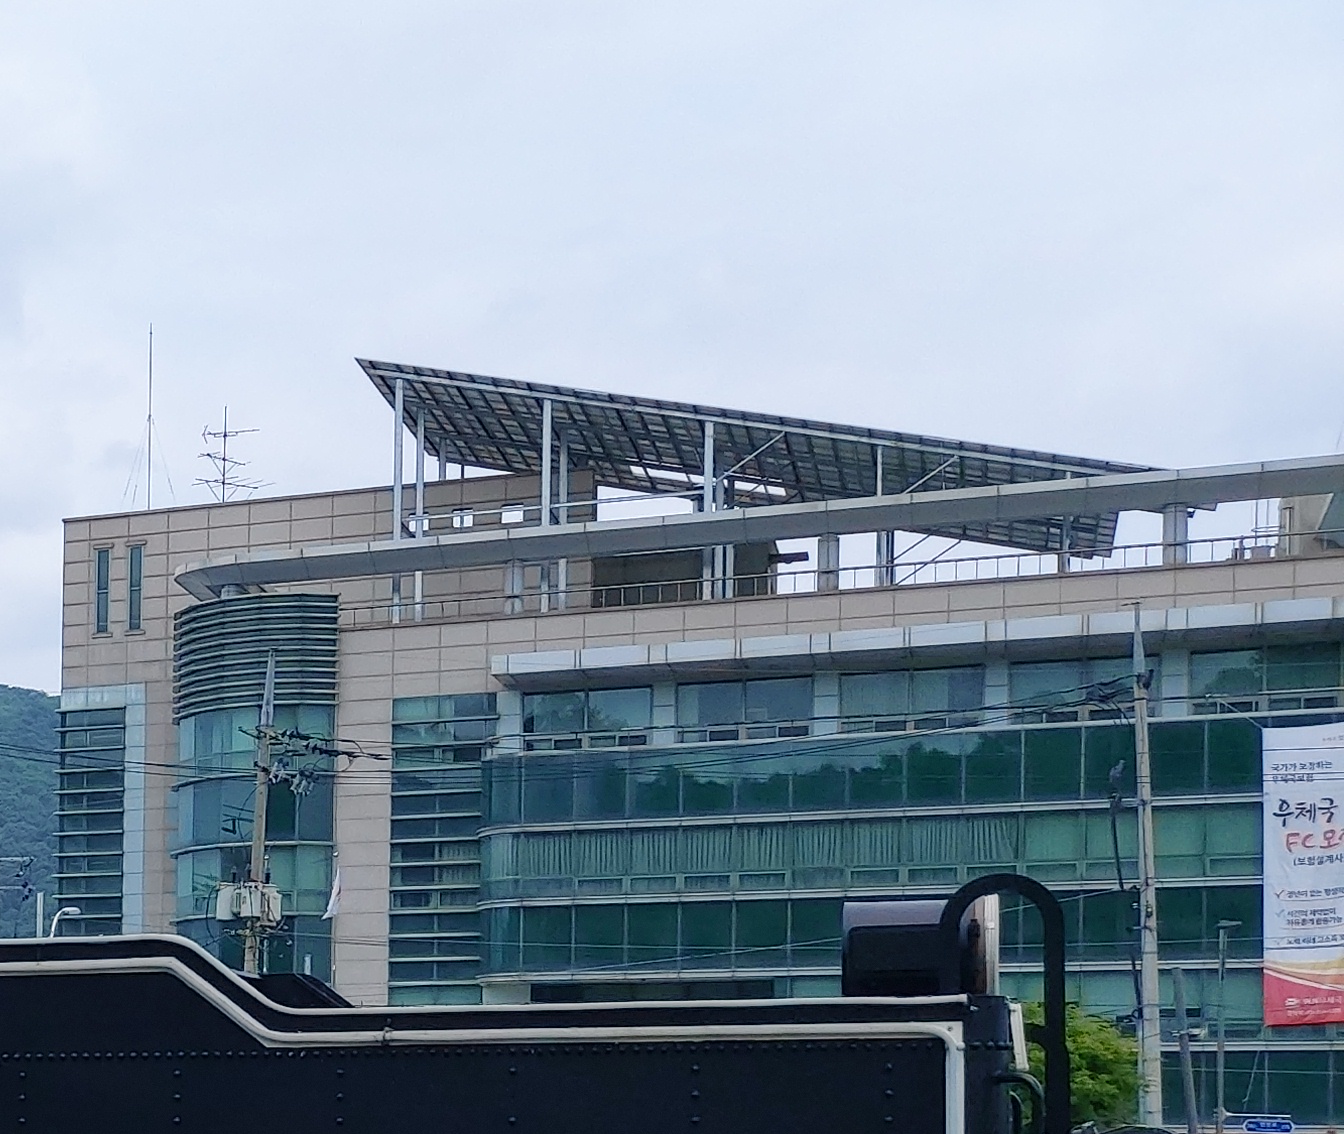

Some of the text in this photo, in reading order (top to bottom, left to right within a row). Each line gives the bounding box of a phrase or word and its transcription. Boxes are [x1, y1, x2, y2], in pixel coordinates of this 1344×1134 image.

[1272, 797, 1339, 828] 우체국
[1285, 828, 1344, 853] FC 모
